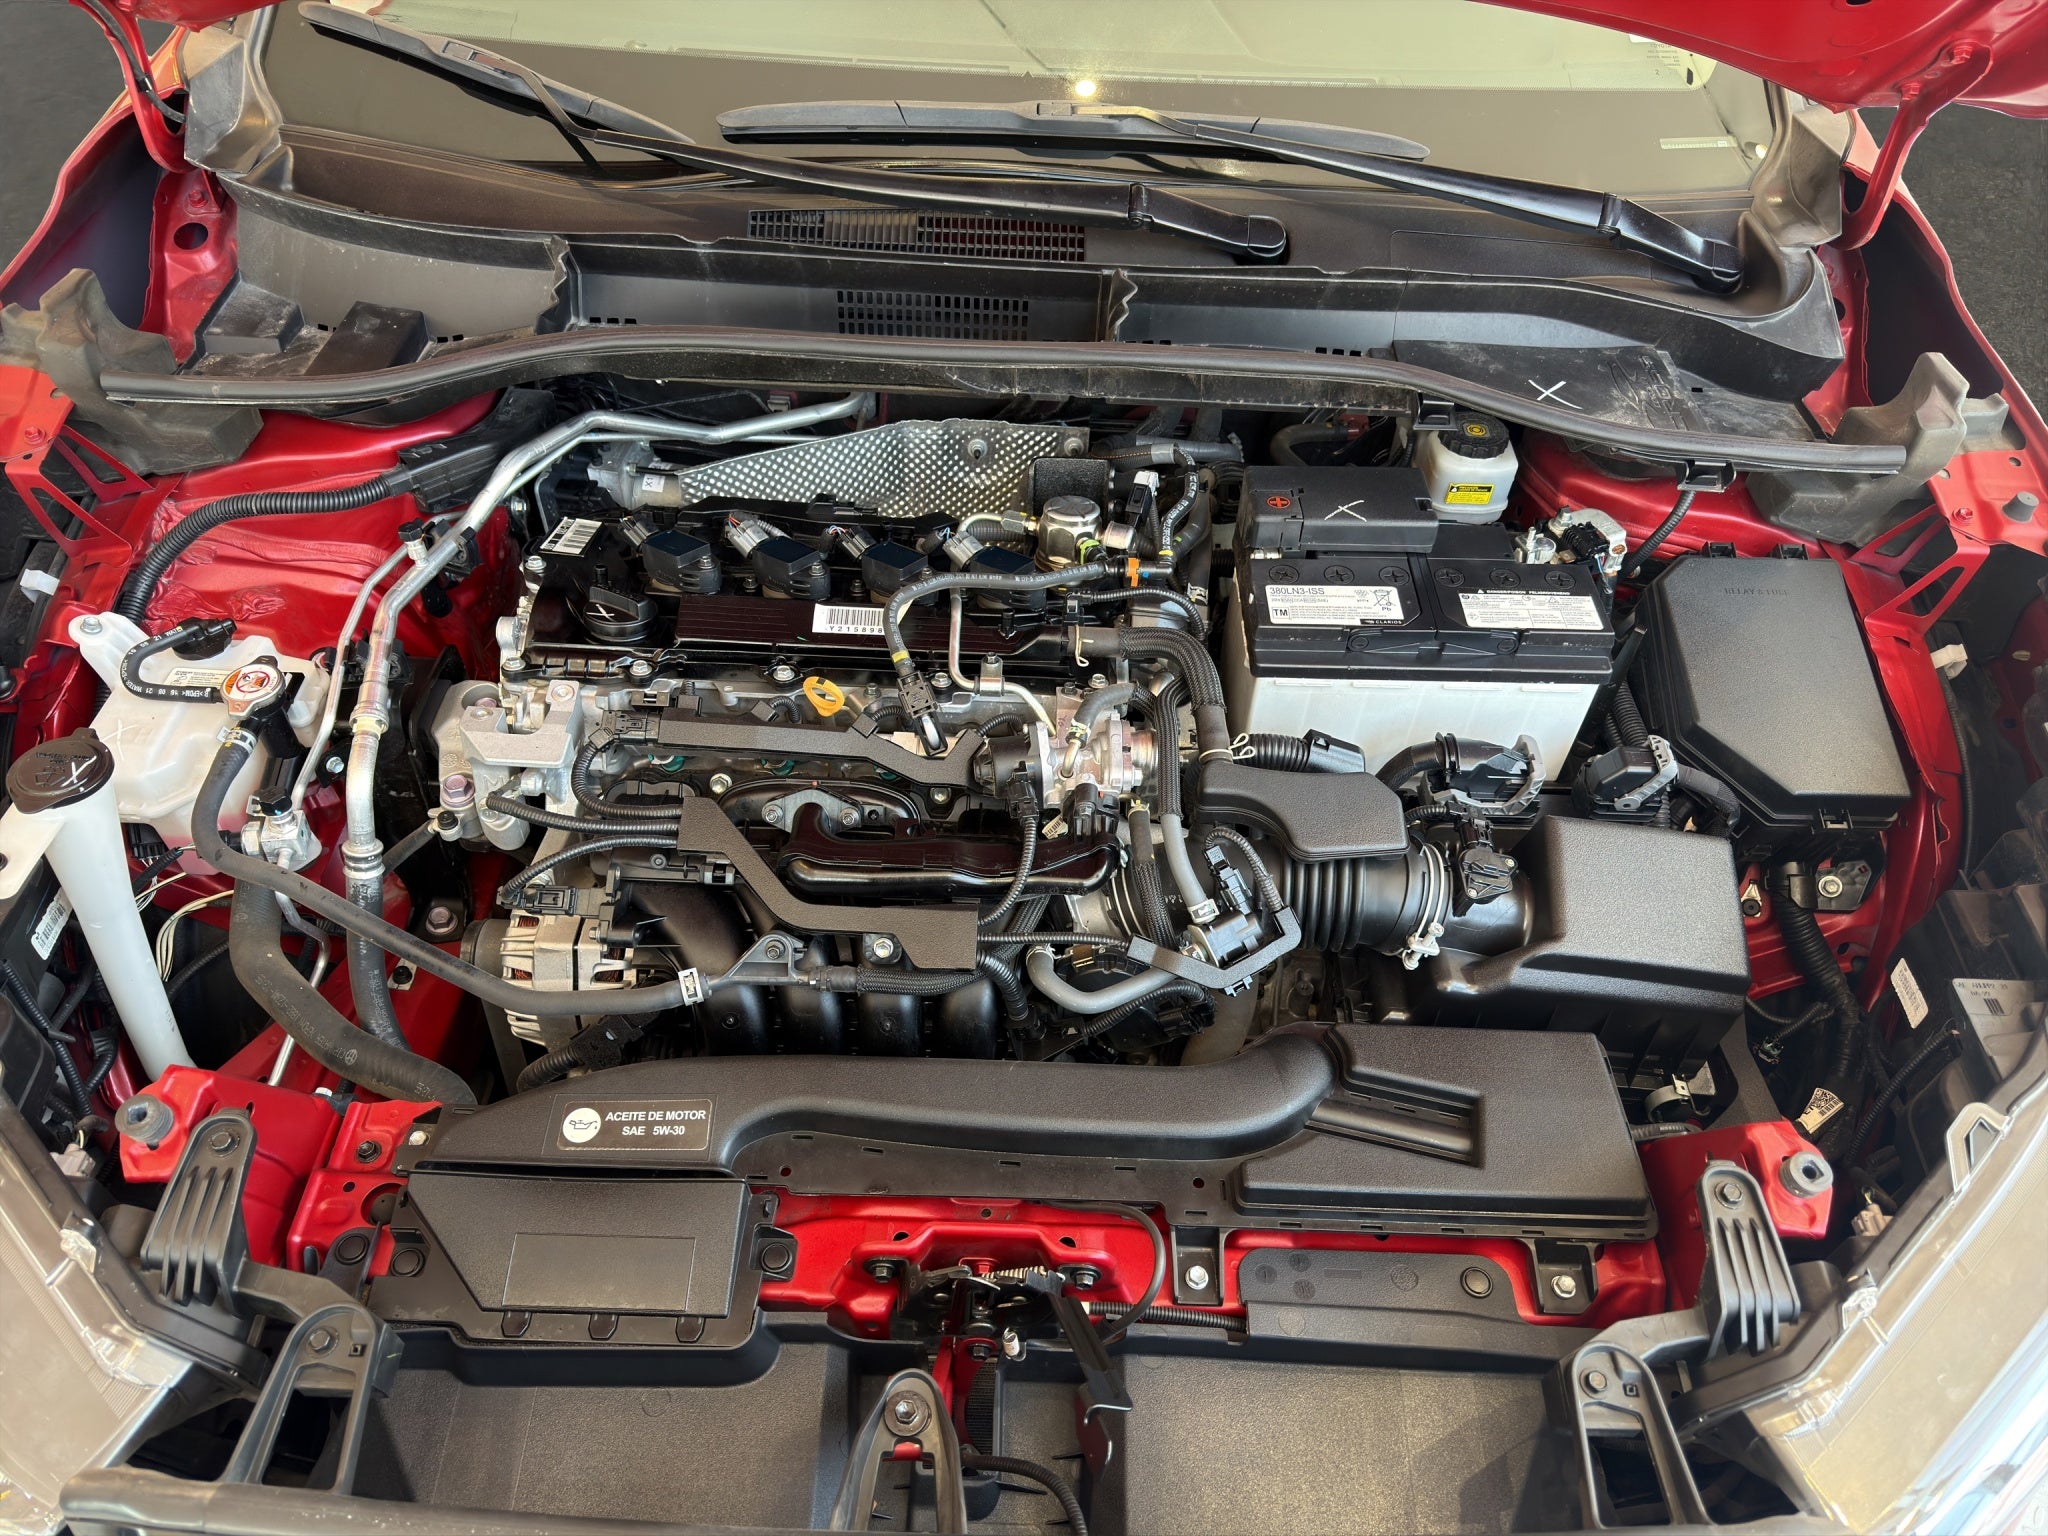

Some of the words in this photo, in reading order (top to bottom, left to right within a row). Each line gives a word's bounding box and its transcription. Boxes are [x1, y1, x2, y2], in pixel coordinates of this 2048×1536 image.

[1269, 587, 1325, 595] 380LN3-ISS
[1273, 608, 1289, 617] TM
[605, 1112, 646, 1121] ACEITE
[648, 1111, 664, 1121] DE
[665, 1110, 706, 1120] MOTOR
[622, 1126, 645, 1136] SAE
[652, 1126, 685, 1136] 5W-30
